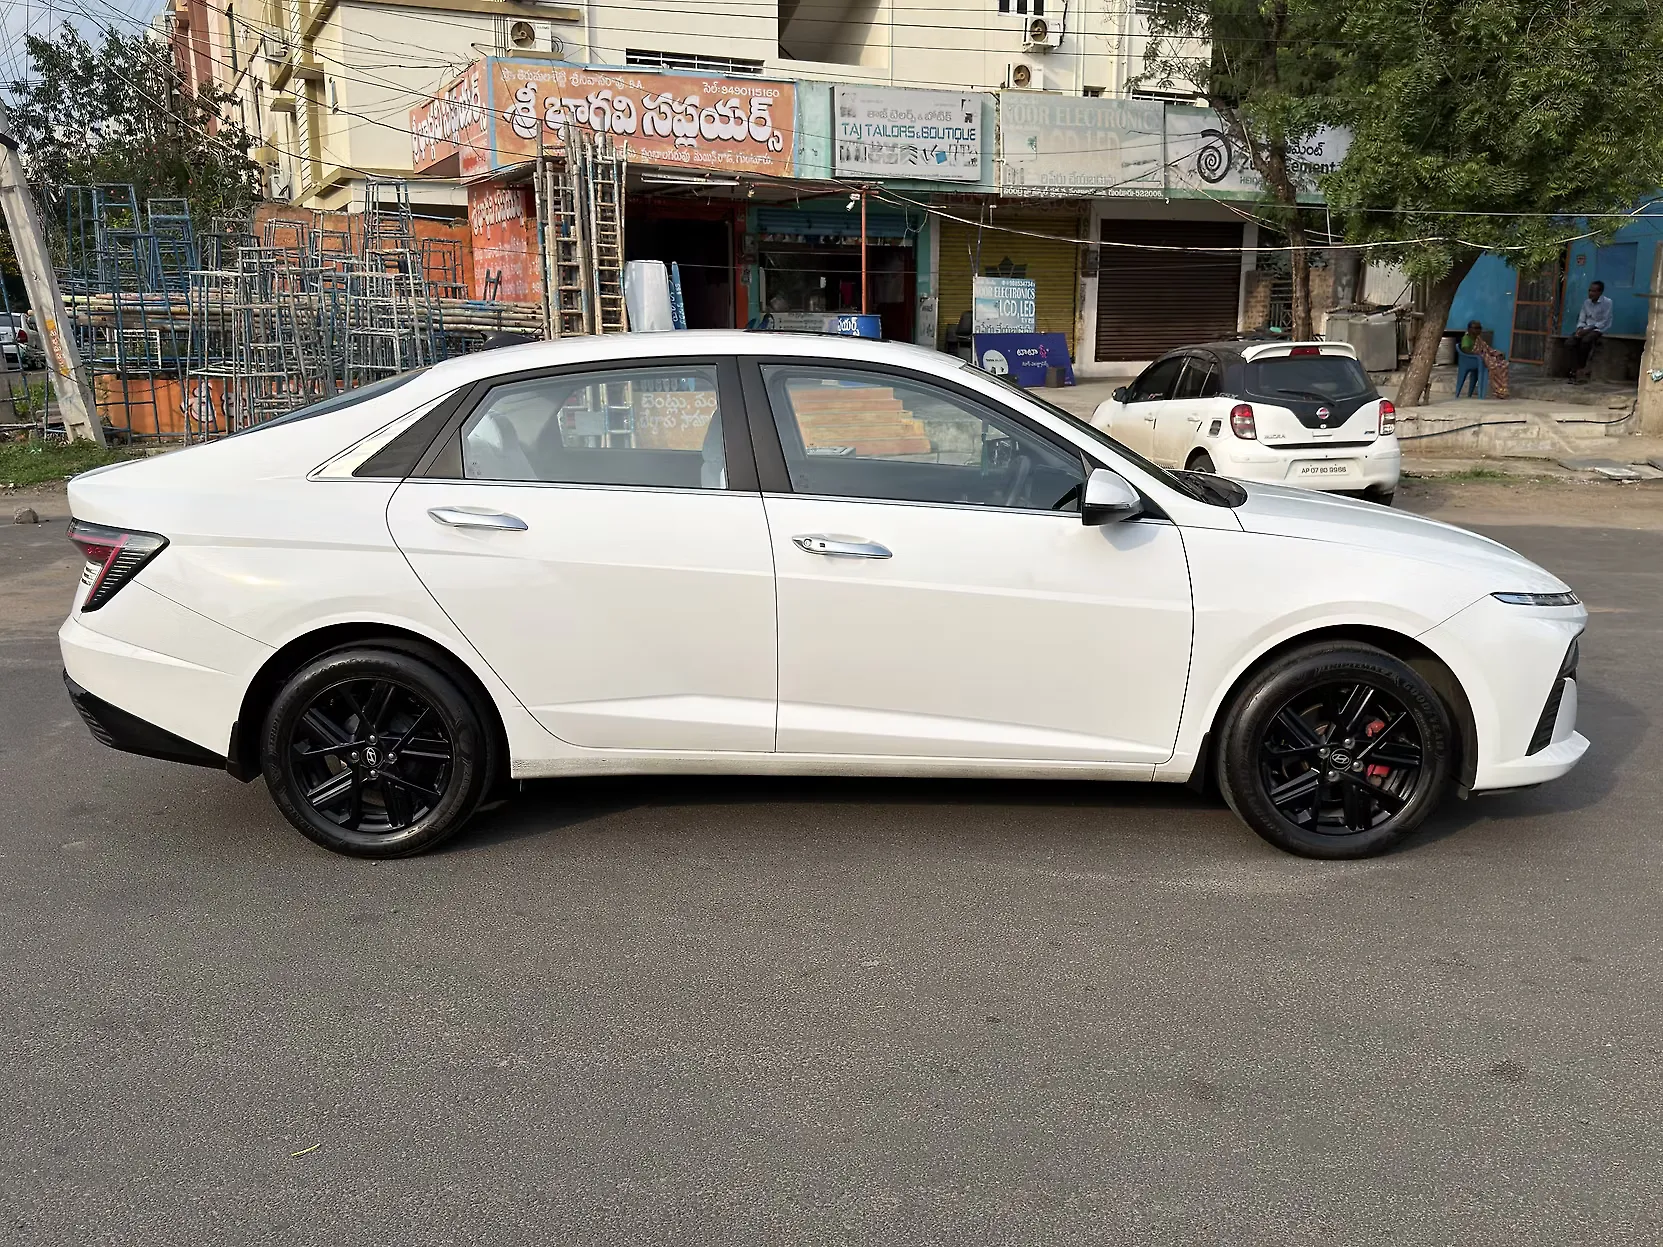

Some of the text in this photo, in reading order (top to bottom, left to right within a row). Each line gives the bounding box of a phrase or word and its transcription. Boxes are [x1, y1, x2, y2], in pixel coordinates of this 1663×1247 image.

[502, 81, 538, 139] శ్రీ
[641, 92, 784, 153] సప్లయర్స్
[841, 123, 862, 139] TAJ
[864, 123, 915, 139] TAILORS
[921, 126, 977, 143] BOUTIQUE
[994, 286, 1036, 300] ELECTRONICS
